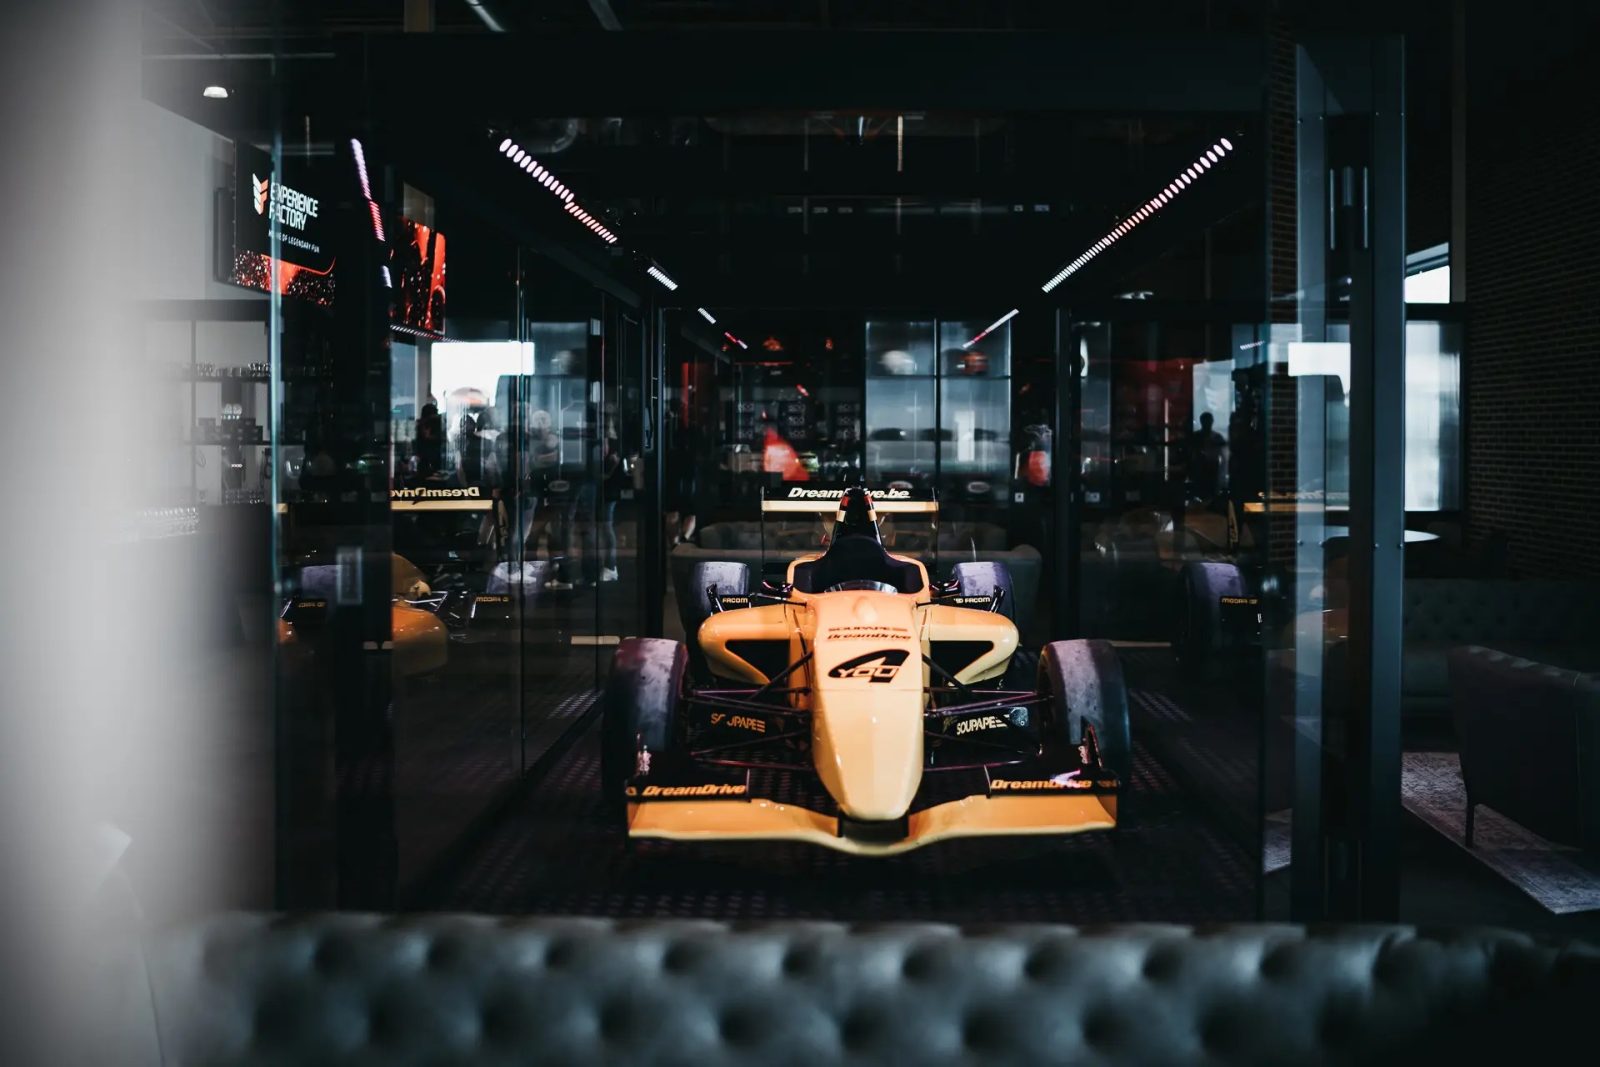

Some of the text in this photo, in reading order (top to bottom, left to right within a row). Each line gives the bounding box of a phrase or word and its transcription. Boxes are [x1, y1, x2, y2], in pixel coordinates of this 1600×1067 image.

[270, 182, 318, 218] EXPERIENCE
[269, 200, 307, 231] FACTORY
[837, 666, 900, 678] YOU
[956, 715, 1000, 736] SOUPAPE
[641, 783, 746, 796] DreamDrive
